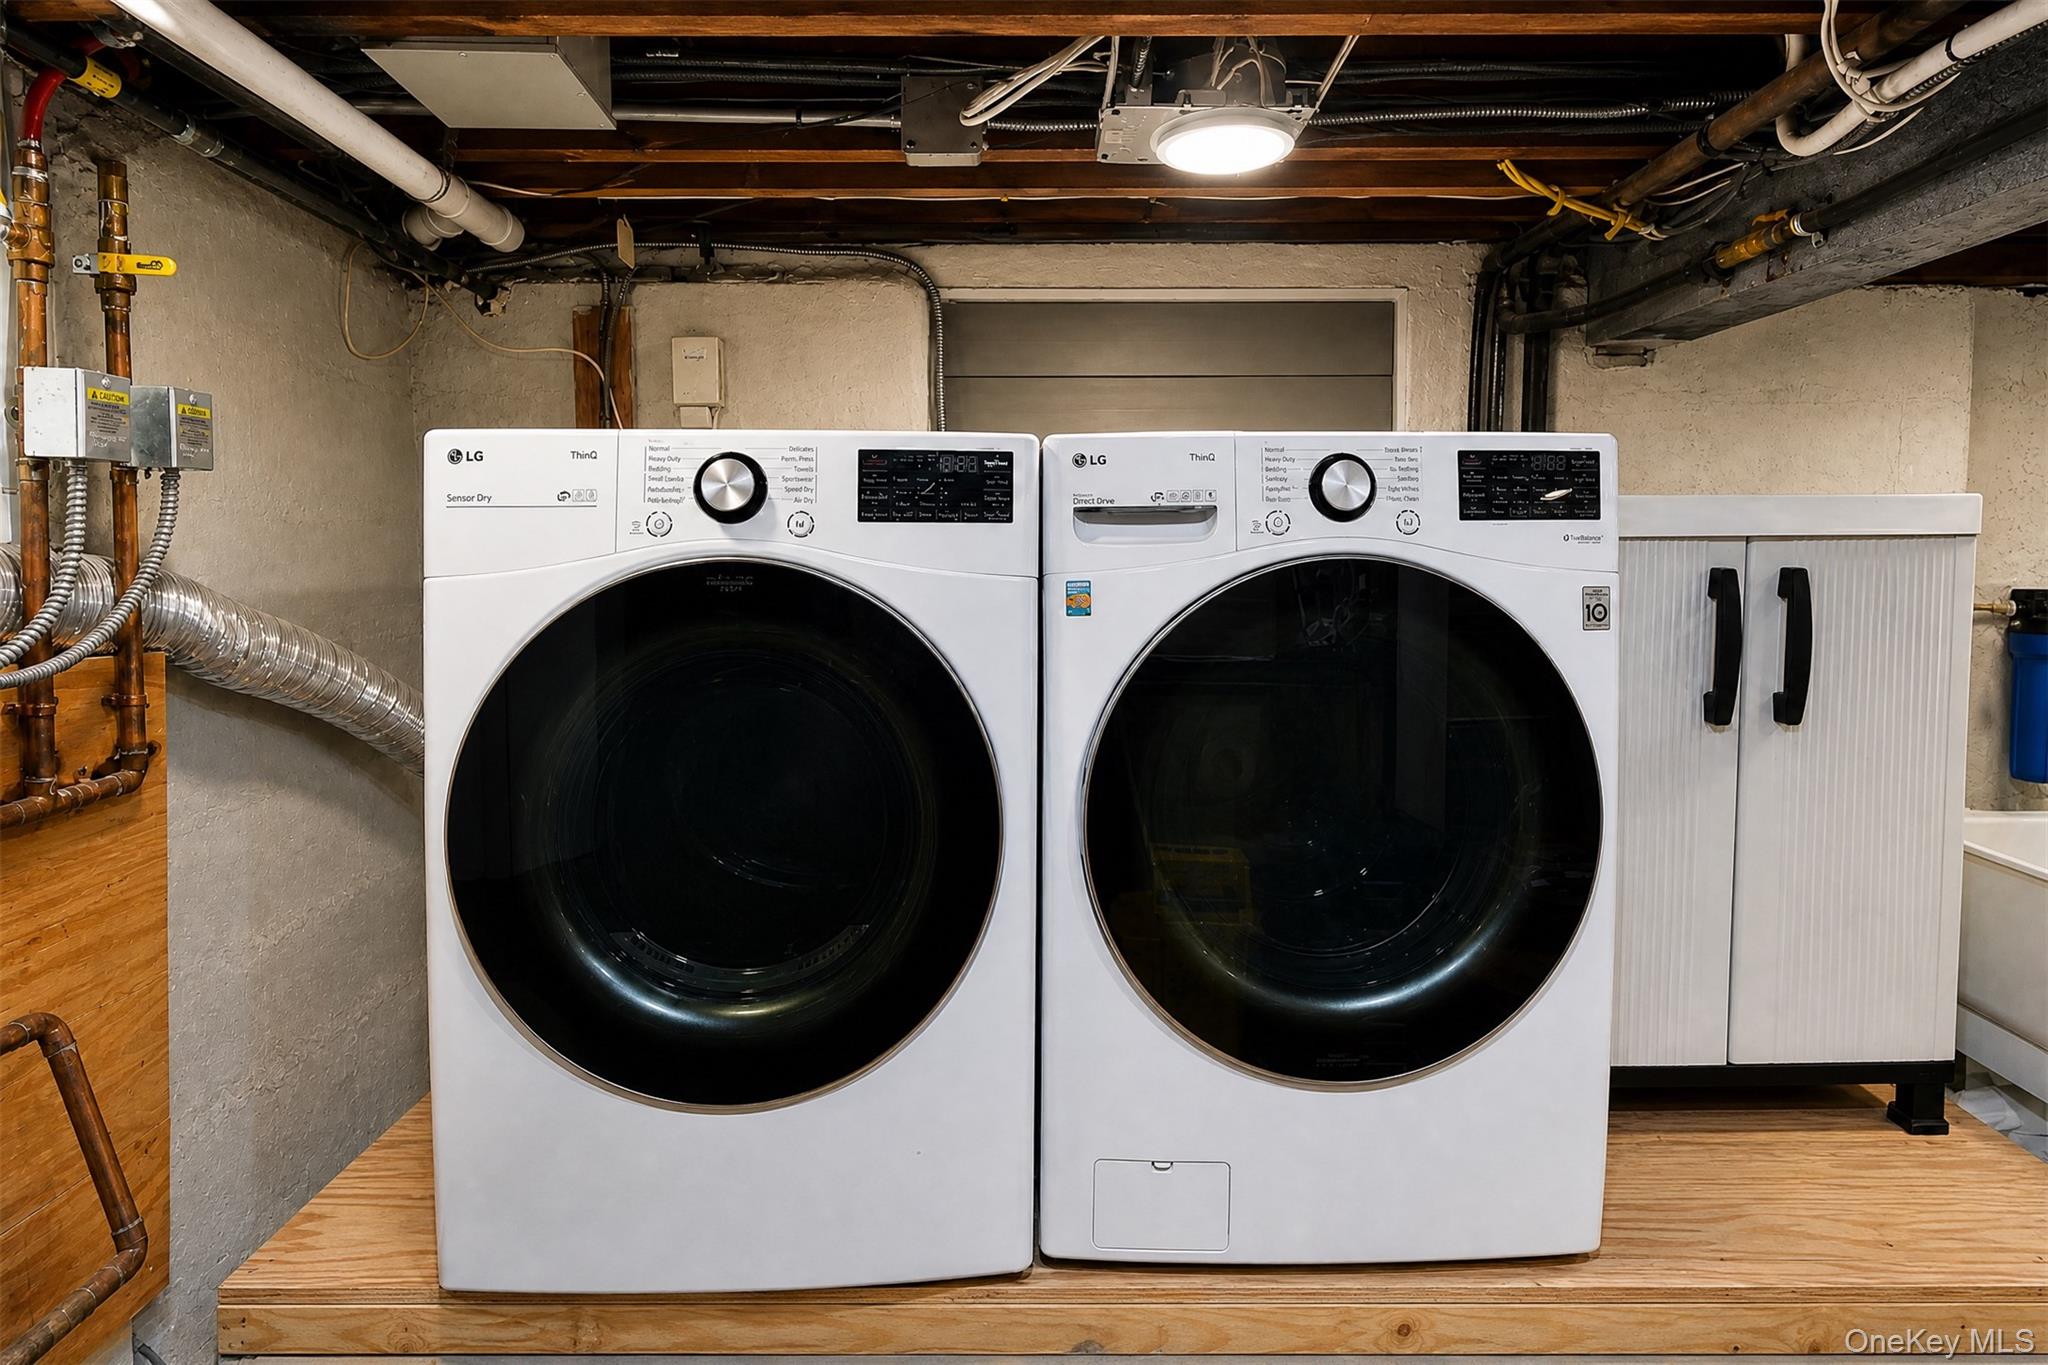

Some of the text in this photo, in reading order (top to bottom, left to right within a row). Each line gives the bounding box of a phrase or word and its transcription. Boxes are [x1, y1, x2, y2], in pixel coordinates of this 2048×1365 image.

[466, 451, 484, 461] LG
[571, 451, 597, 460] ThinQ
[1090, 455, 1107, 465] LG
[1190, 453, 1215, 461] ThinQ
[447, 494, 492, 503] Sensor Dry
[1585, 603, 1608, 622] 10
